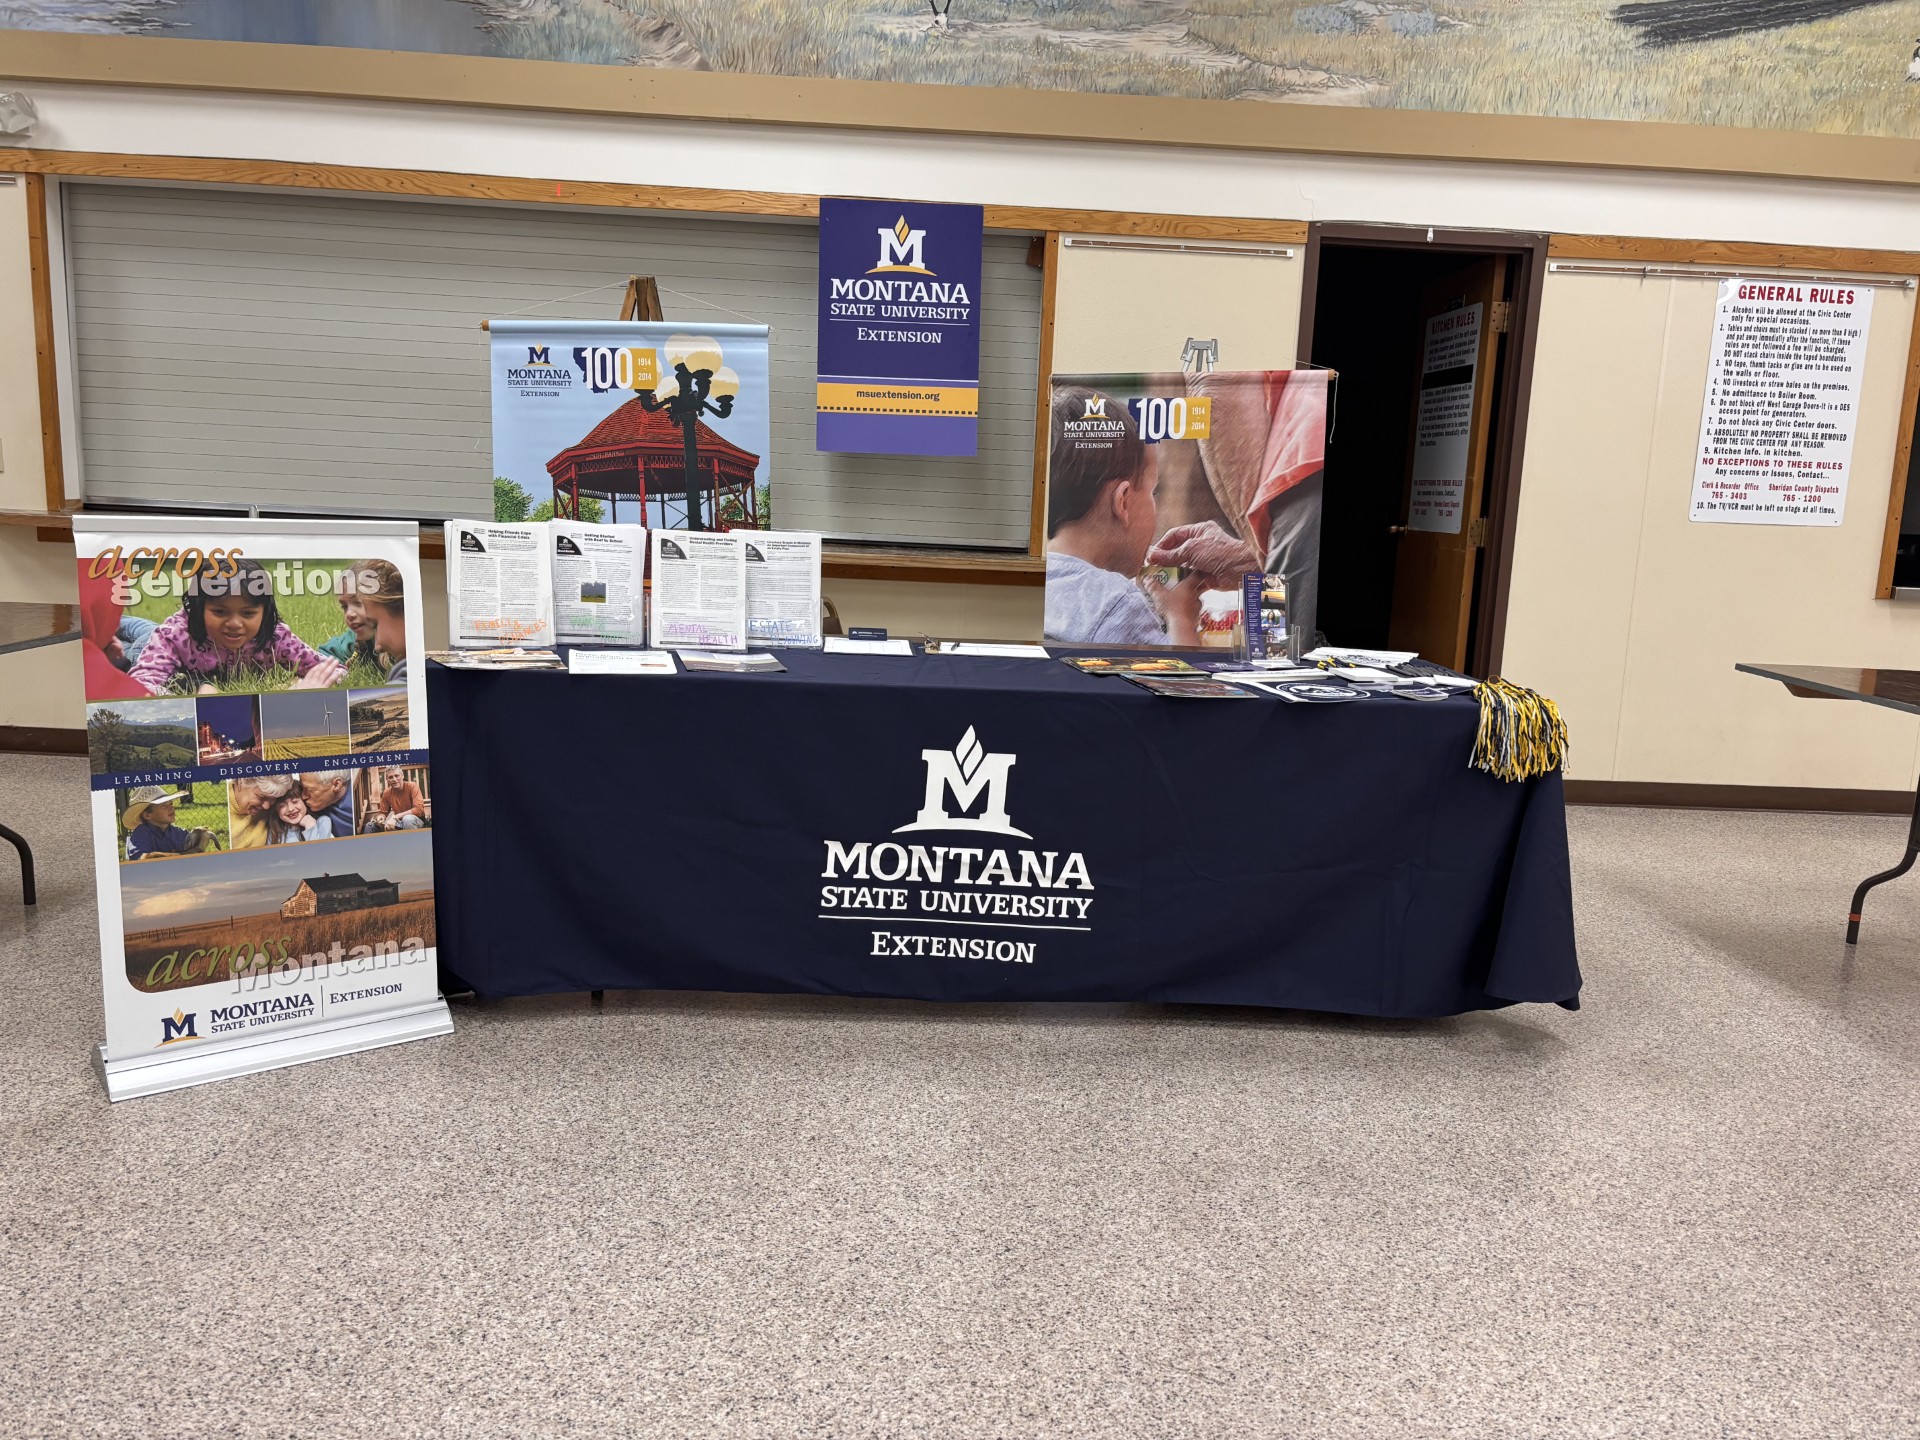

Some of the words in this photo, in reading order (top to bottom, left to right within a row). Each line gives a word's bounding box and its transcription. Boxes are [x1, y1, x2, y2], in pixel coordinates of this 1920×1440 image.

[830, 278, 970, 304] MONTANA
[1737, 284, 1803, 302] GENERAL
[1809, 288, 1855, 304] RULES
[830, 303, 875, 316] STATE
[881, 305, 970, 320] UNIVERSITY
[1432, 318, 1454, 334] KITCHEN
[1456, 311, 1475, 328] RULES
[1730, 314, 1743, 322] only
[1756, 315, 1778, 324] special
[637, 358, 652, 366] 1914
[507, 369, 572, 380] MONTANA
[581, 347, 633, 390] 100
[638, 372, 652, 381] 2014
[856, 390, 940, 402] msuextension.org
[1732, 389, 1767, 397] admittance
[1192, 407, 1206, 415] 1914
[1136, 397, 1187, 440] 100
[1063, 421, 1126, 431] MONTANA
[1191, 422, 1205, 430] 2014
[1713, 428, 1748, 436] ABSOLUTELY
[1760, 430, 1790, 438] PROPERTY
[1820, 432, 1847, 440] REMOVED
[1713, 446, 1742, 455] Kitchen
[1744, 448, 1761, 456] Info.
[1772, 449, 1802, 458] kitchen.
[1717, 458, 1769, 466] EXCEPTIONS
[1714, 468, 1727, 476] Any
[1794, 485, 1813, 493] County
[1814, 485, 1839, 494] Dispatch
[88, 545, 243, 579] across
[111, 561, 382, 606] generations
[669, 624, 708, 633] MENTAL
[750, 620, 792, 632] ESTATE
[698, 635, 738, 644] HEALTH
[771, 634, 818, 645] PLANNING
[324, 753, 410, 767] ENGAGEMENT
[220, 762, 300, 776] DISCOVERY
[114, 771, 193, 785] LEARNING
[821, 840, 1095, 890] MONTANA
[820, 885, 908, 910] STATE
[919, 890, 1094, 919] UNIVERSITY
[145, 934, 293, 986] across
[229, 936, 427, 994] Montana
[210, 993, 314, 1024] MONTANA
[211, 1020, 246, 1034] STATE
[249, 1007, 315, 1027] UNIVERSITY
